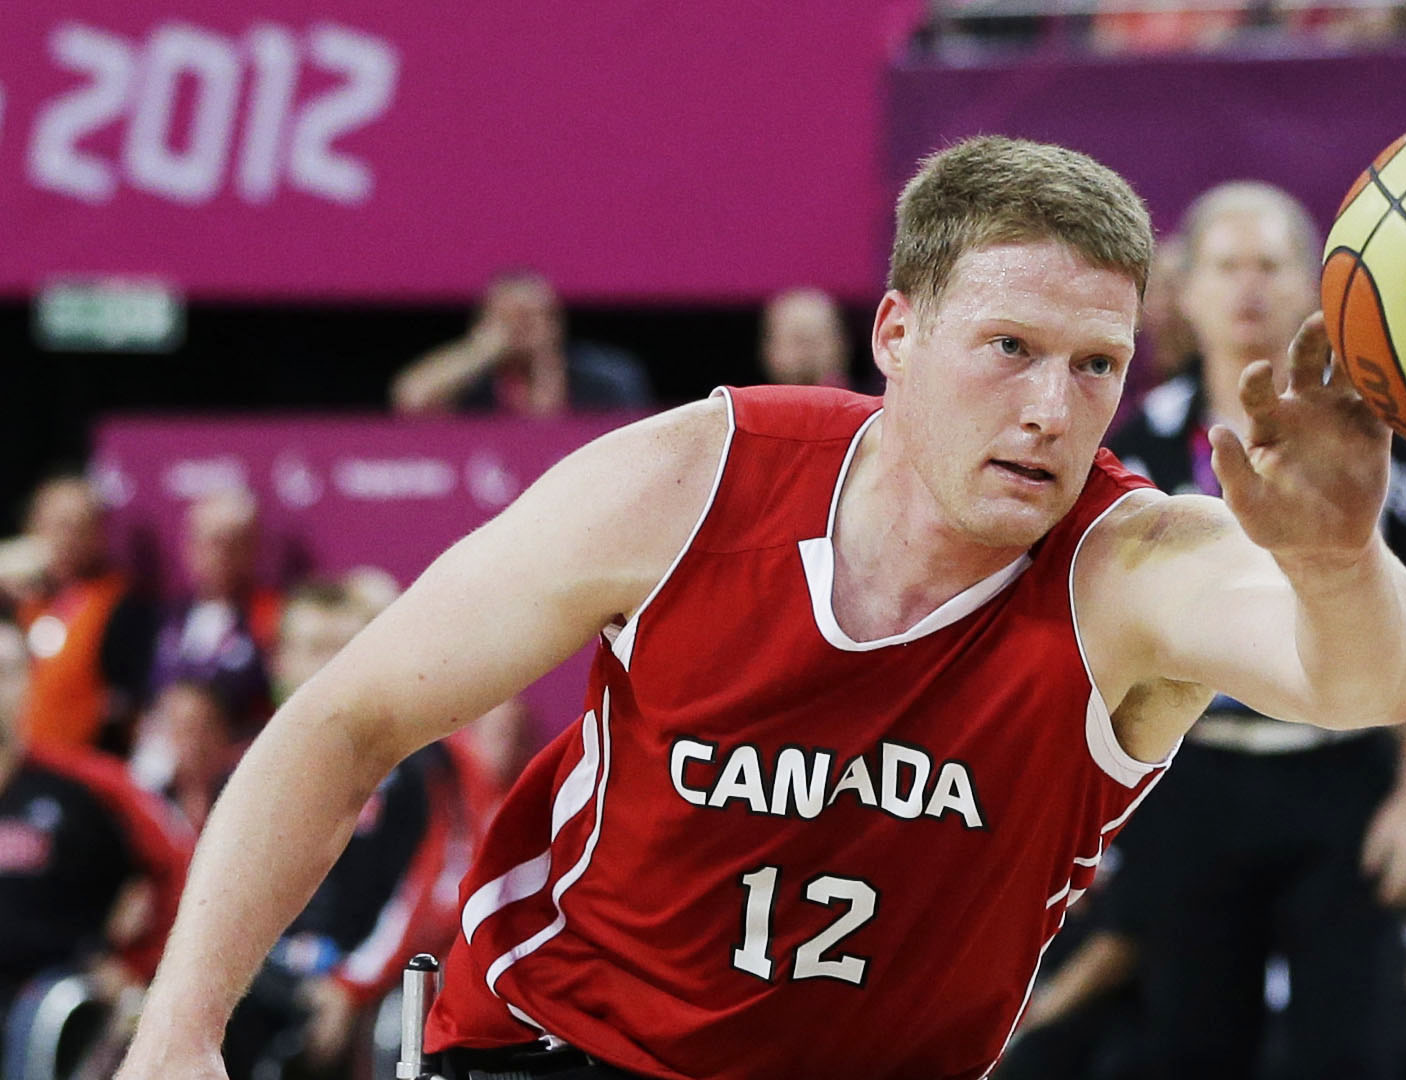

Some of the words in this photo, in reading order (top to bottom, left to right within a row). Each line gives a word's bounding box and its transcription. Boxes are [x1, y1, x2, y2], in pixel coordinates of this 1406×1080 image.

[27, 22, 396, 204] 2012
[669, 738, 988, 831] CANADA
[731, 864, 880, 986] 12
